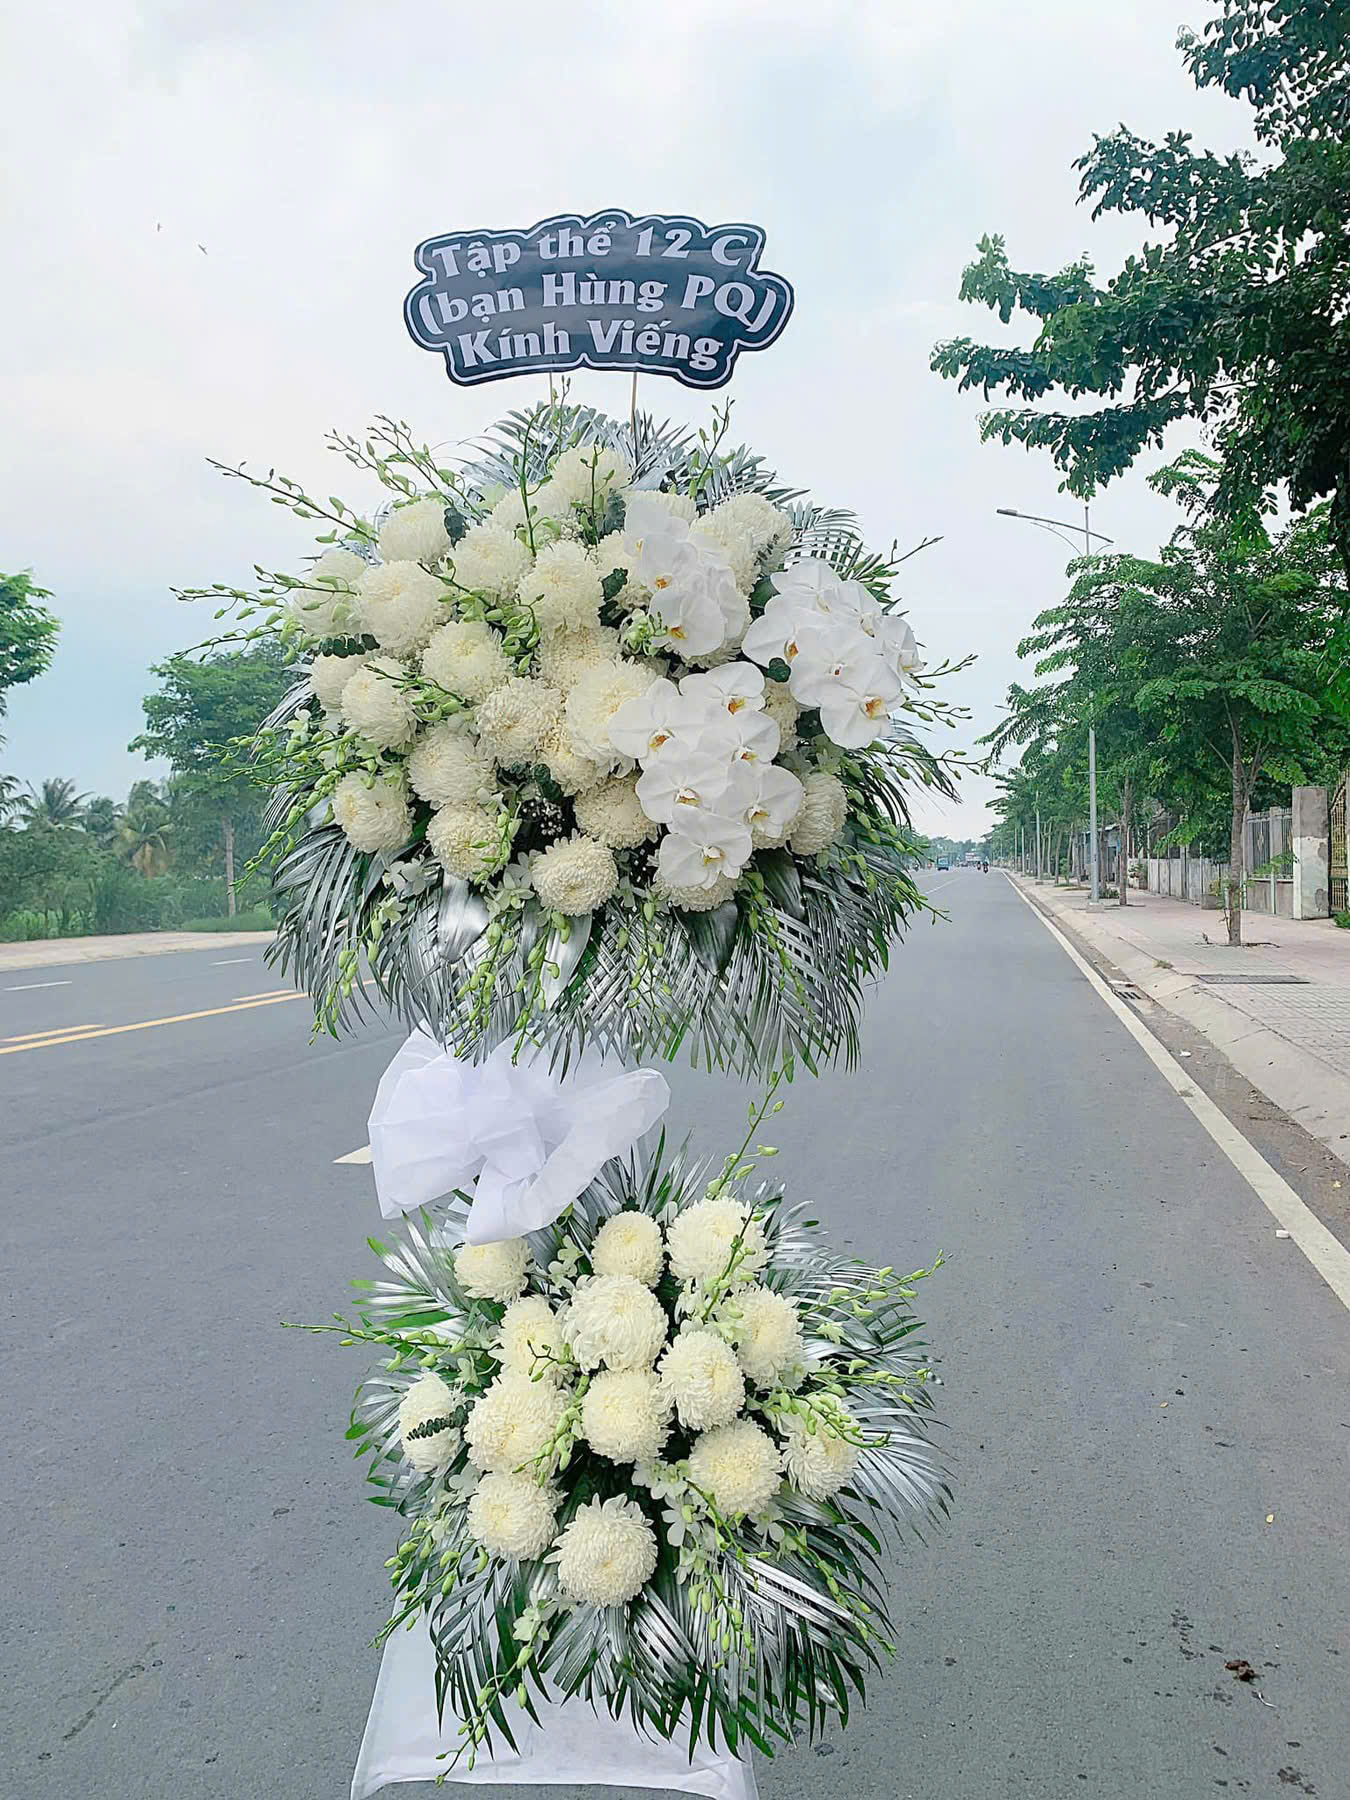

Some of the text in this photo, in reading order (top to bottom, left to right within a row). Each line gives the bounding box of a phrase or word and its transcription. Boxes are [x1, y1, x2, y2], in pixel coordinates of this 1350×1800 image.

[432, 221, 749, 278] Tập thể 12 C
[418, 272, 777, 335] (bạn Hùng PQ)
[457, 319, 724, 371] Kính Viếng
